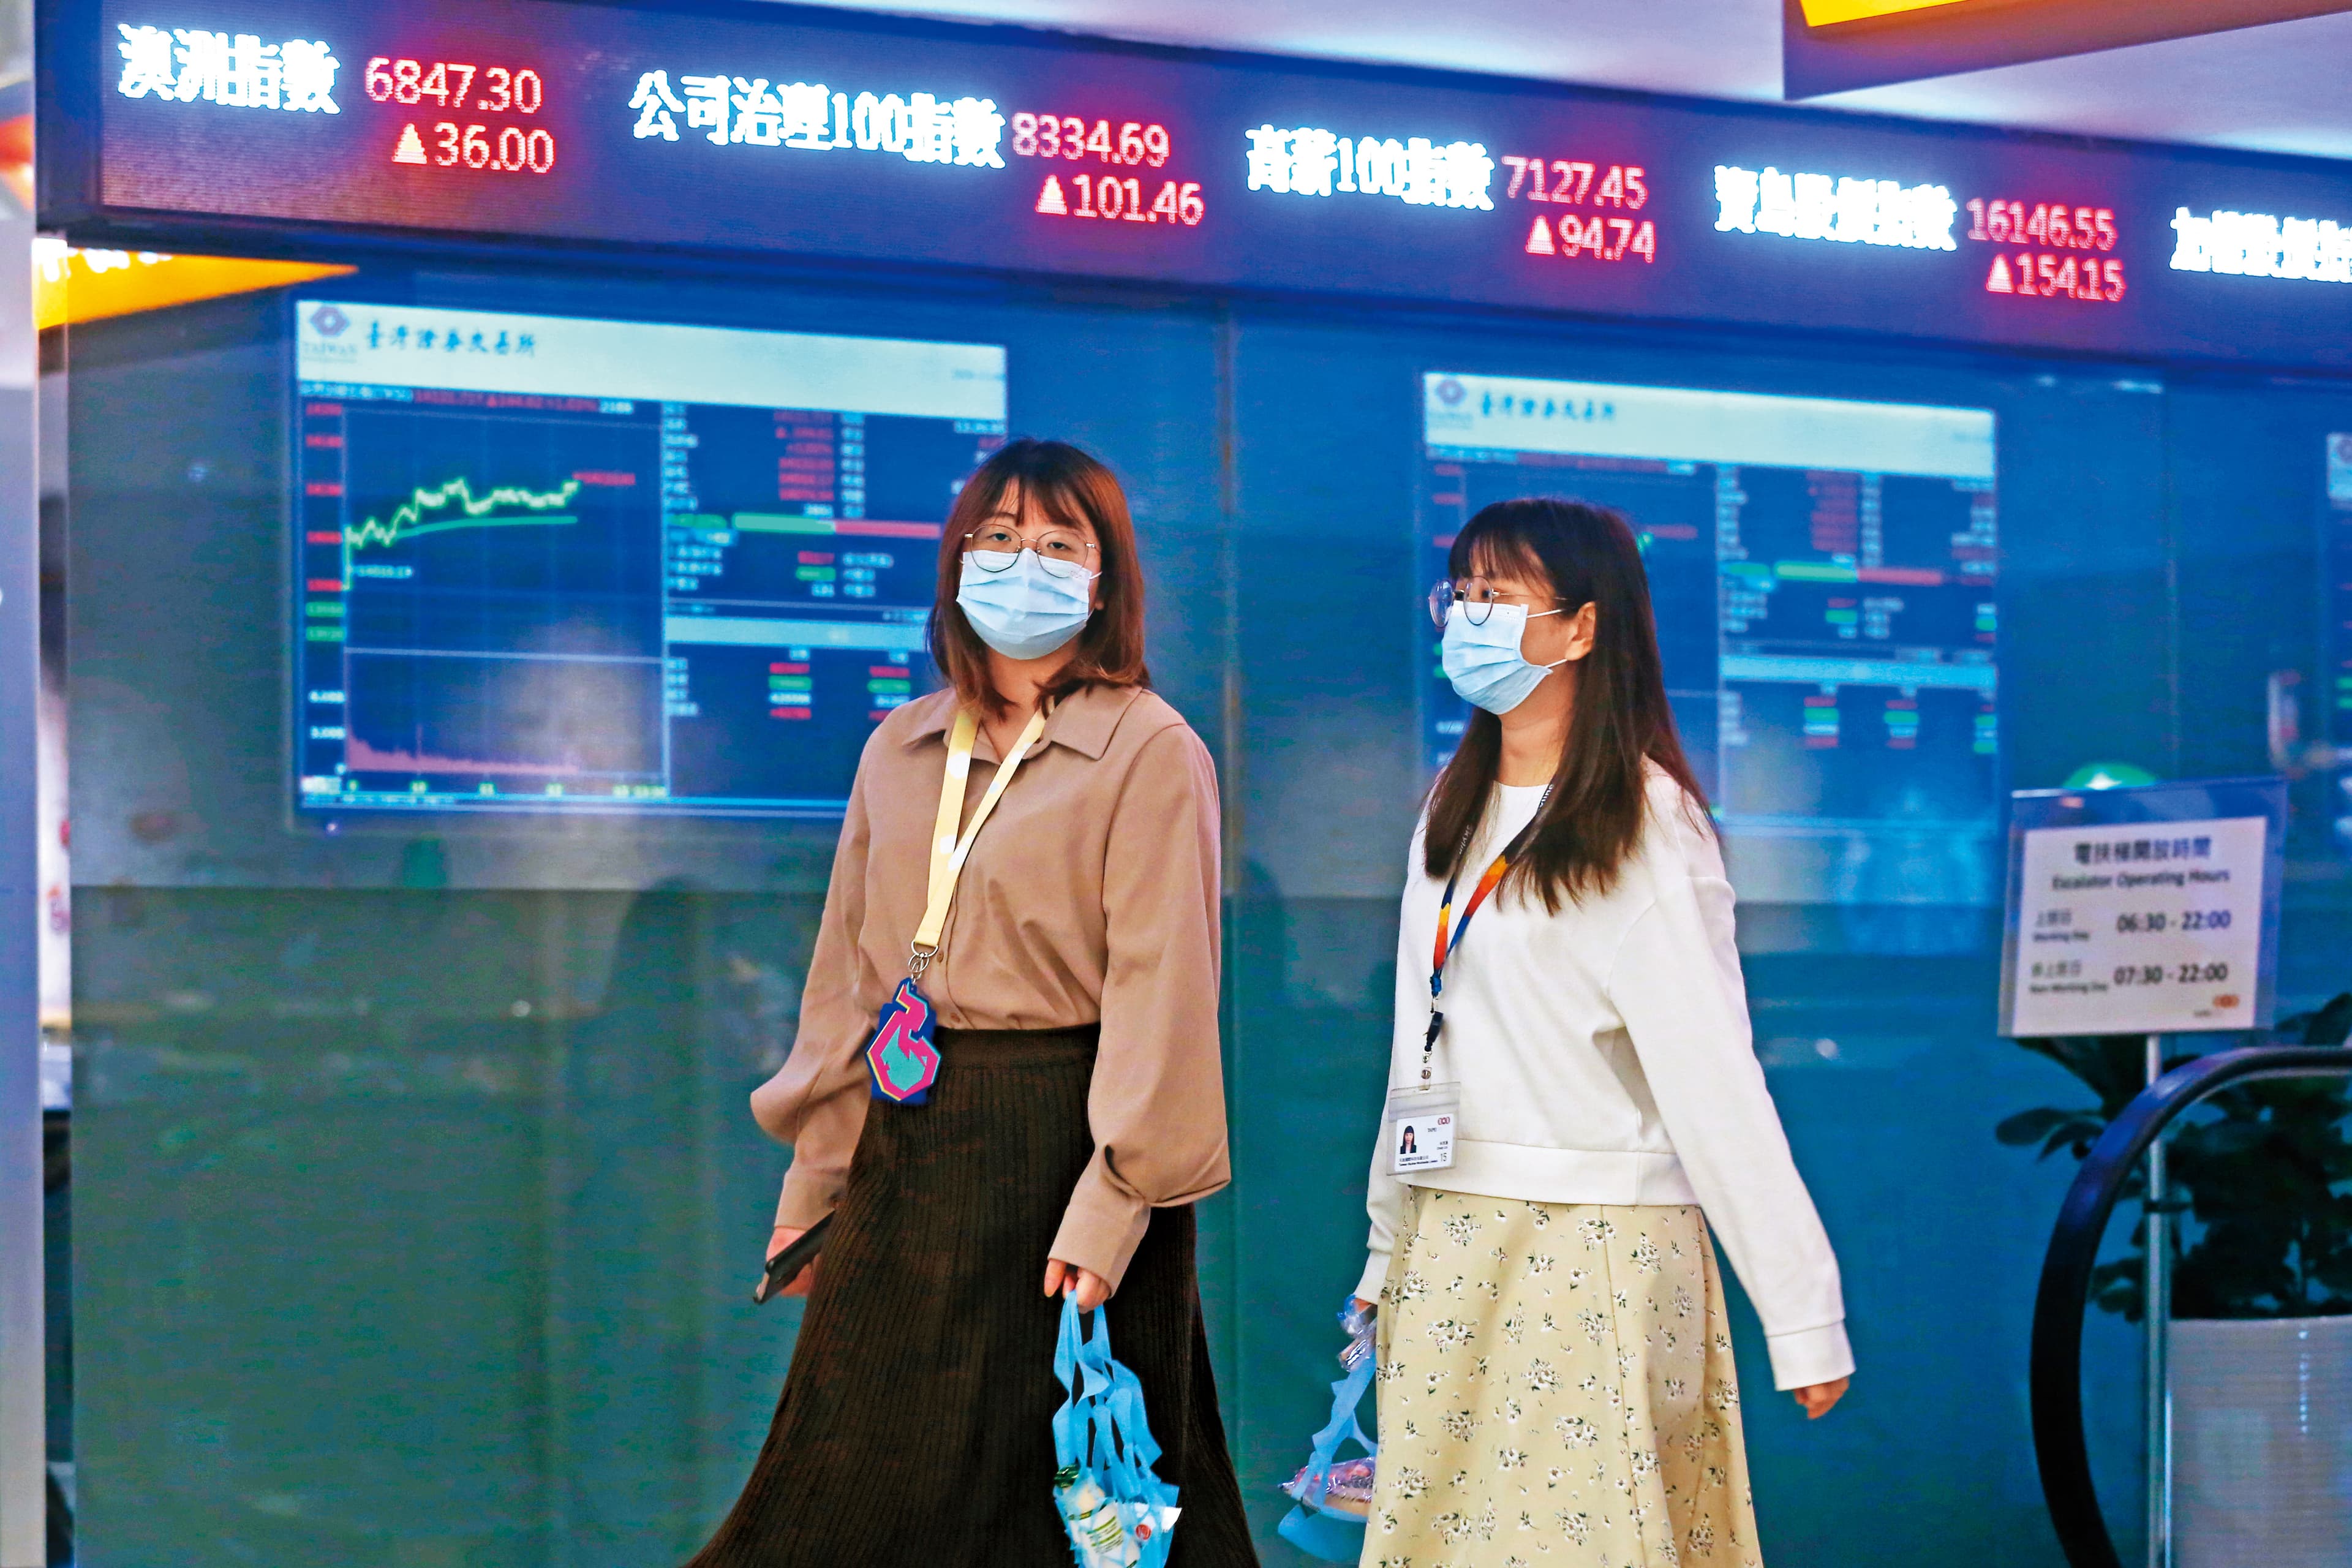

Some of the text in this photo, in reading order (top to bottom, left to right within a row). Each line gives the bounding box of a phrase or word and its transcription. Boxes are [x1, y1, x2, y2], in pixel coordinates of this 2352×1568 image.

[118, 23, 341, 115] 澳洲指數
[365, 57, 543, 115] 6847.30
[628, 69, 1006, 169] 公司治理100指數
[1012, 111, 1171, 167] 8334.69
[434, 122, 556, 174] 36.00
[1072, 173, 1205, 225] 101.46
[1501, 156, 1649, 211] 7127.45
[1558, 214, 1656, 263] 94.74
[1966, 198, 2117, 251] 16146.55
[2016, 252, 2125, 301] 154.15
[2116, 912, 2168, 935] 06:30
[2181, 911, 2232, 932] 22:00
[2114, 965, 2165, 987] 07:30
[2177, 962, 2230, 985] 22:00
